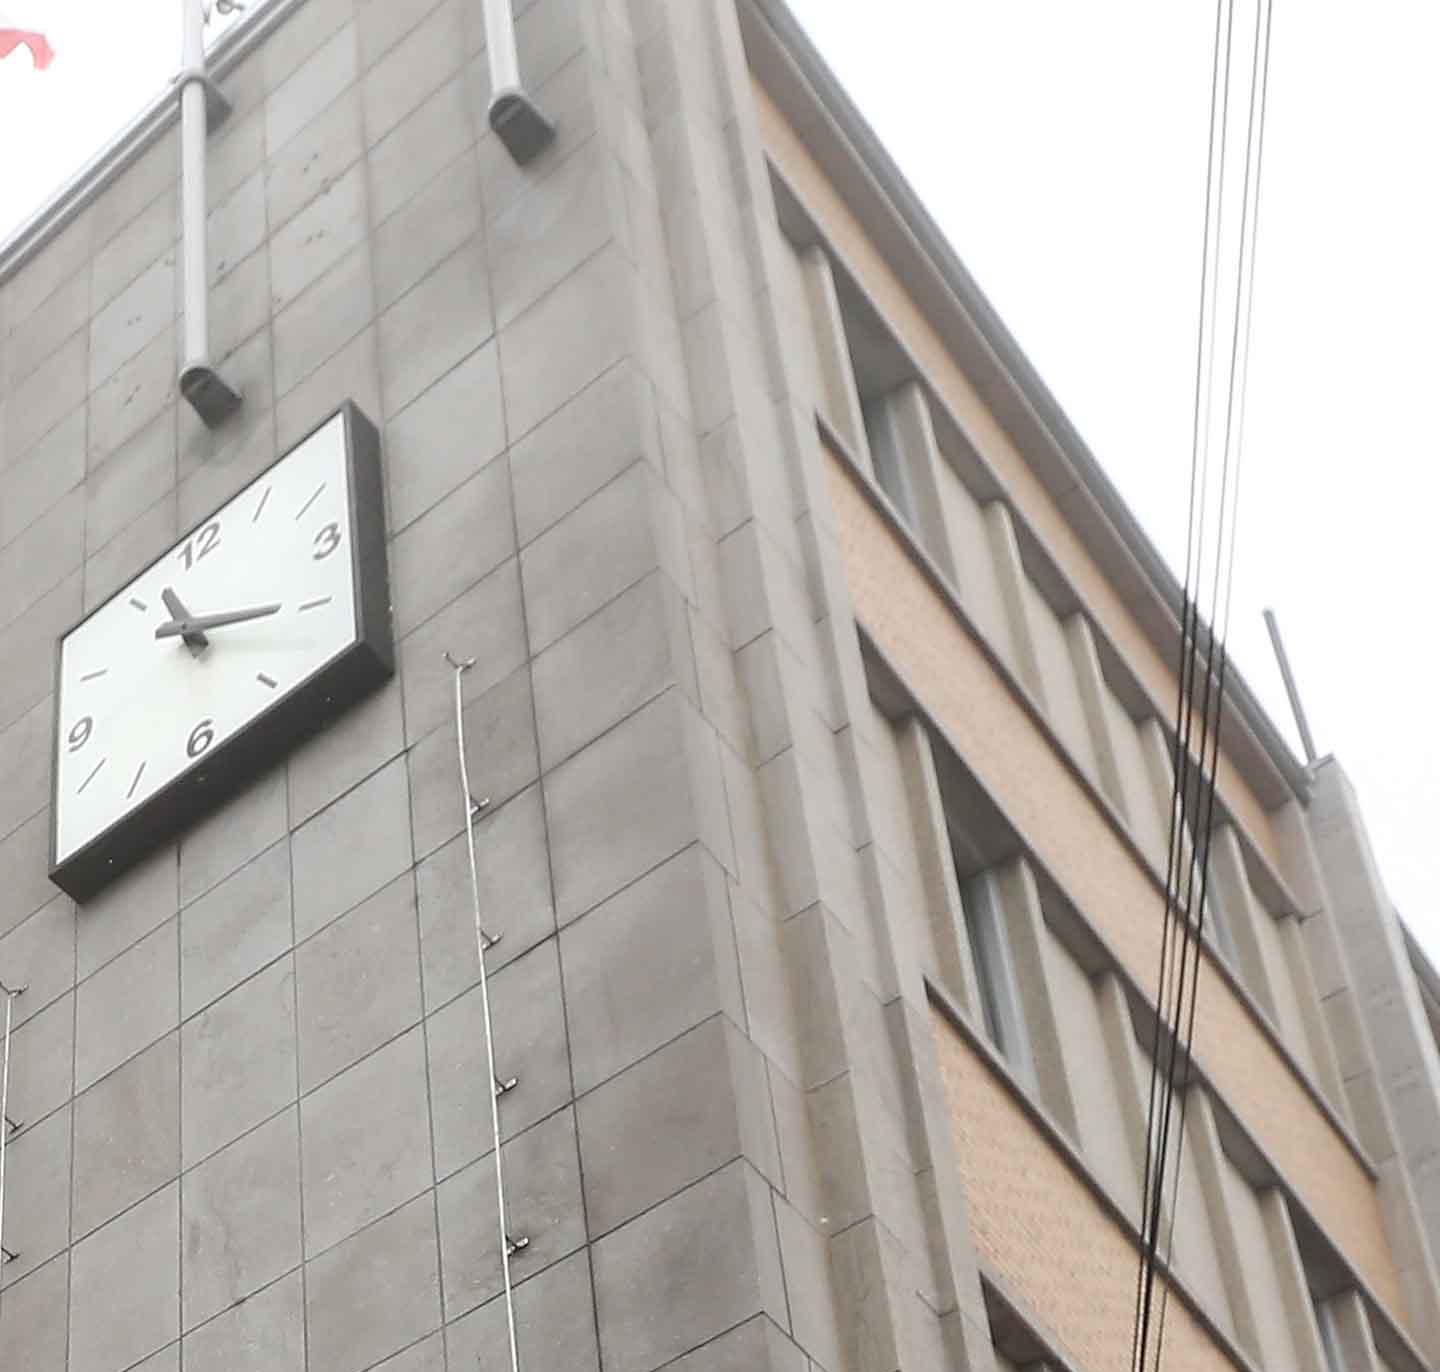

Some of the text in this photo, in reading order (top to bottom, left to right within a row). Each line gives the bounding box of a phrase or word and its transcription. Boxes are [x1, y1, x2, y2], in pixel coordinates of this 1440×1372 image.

[176, 522, 221, 570] 12
[314, 523, 342, 560] 3
[68, 717, 93, 752] 9
[187, 720, 214, 758] 6
